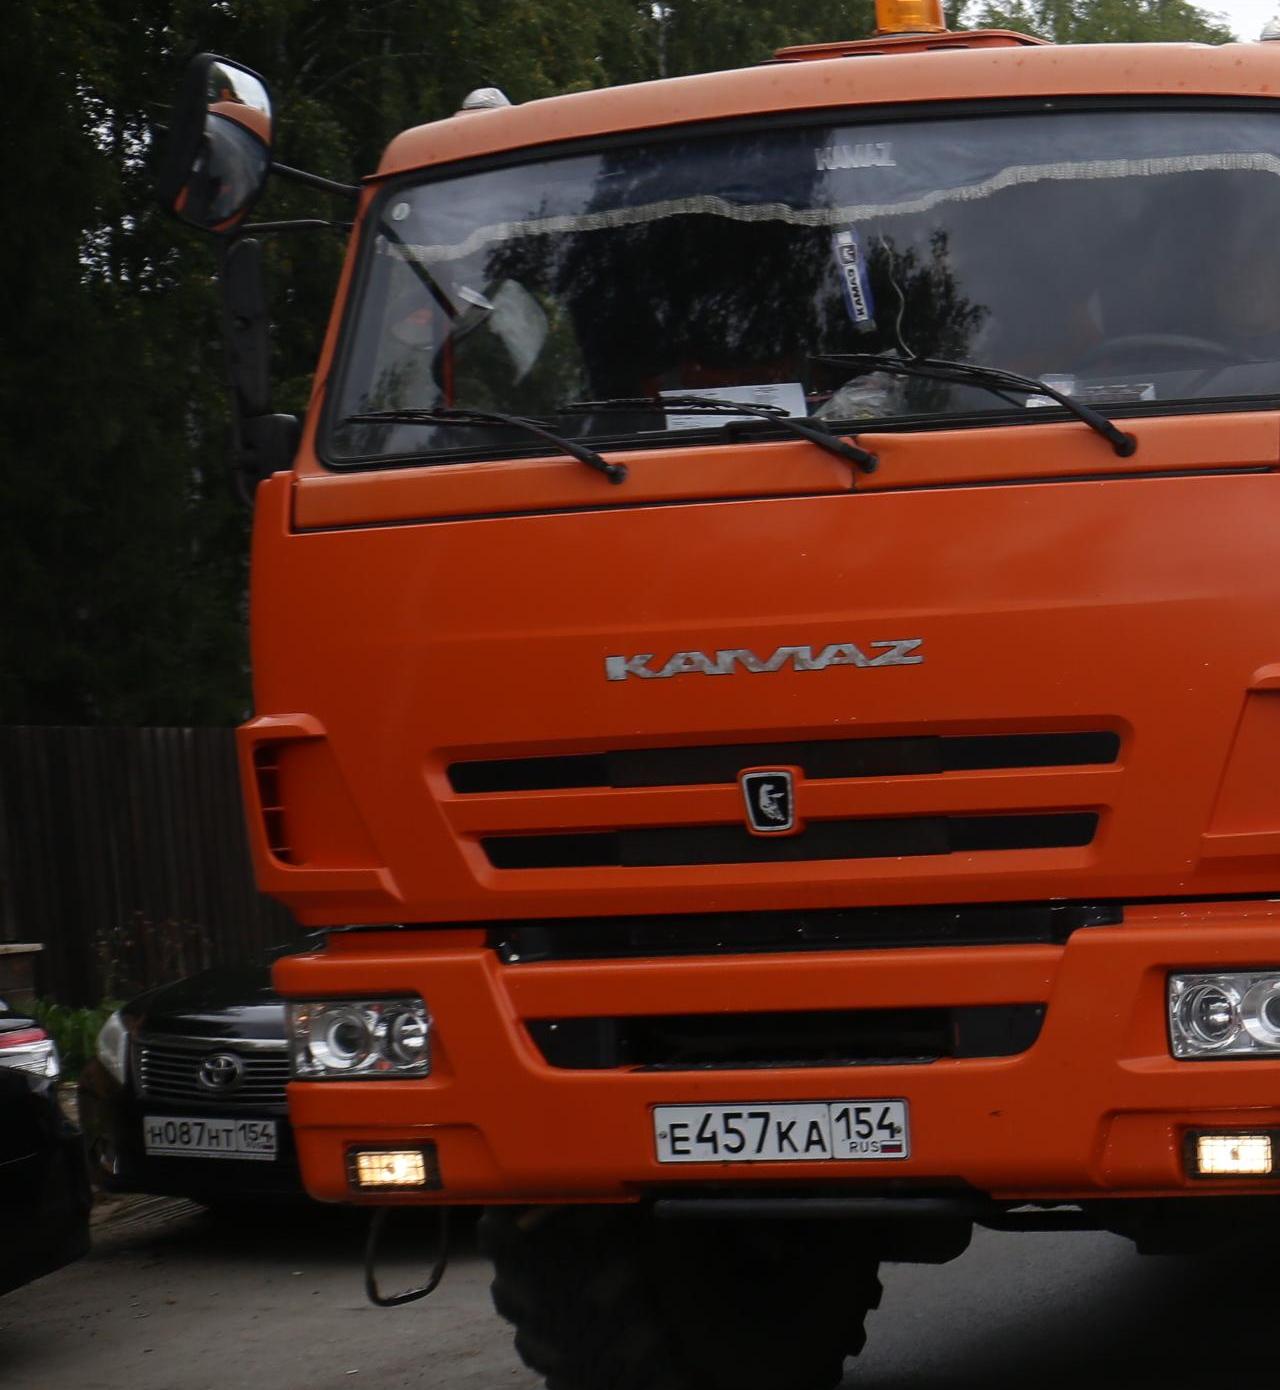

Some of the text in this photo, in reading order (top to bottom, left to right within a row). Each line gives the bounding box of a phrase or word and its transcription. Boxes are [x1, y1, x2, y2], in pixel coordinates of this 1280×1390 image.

[605, 638, 925, 682] KAMAZ
[238, 1123, 274, 1142] 154
[668, 1106, 897, 1156] Е457КА 154
[849, 1141, 880, 1154] RUS
